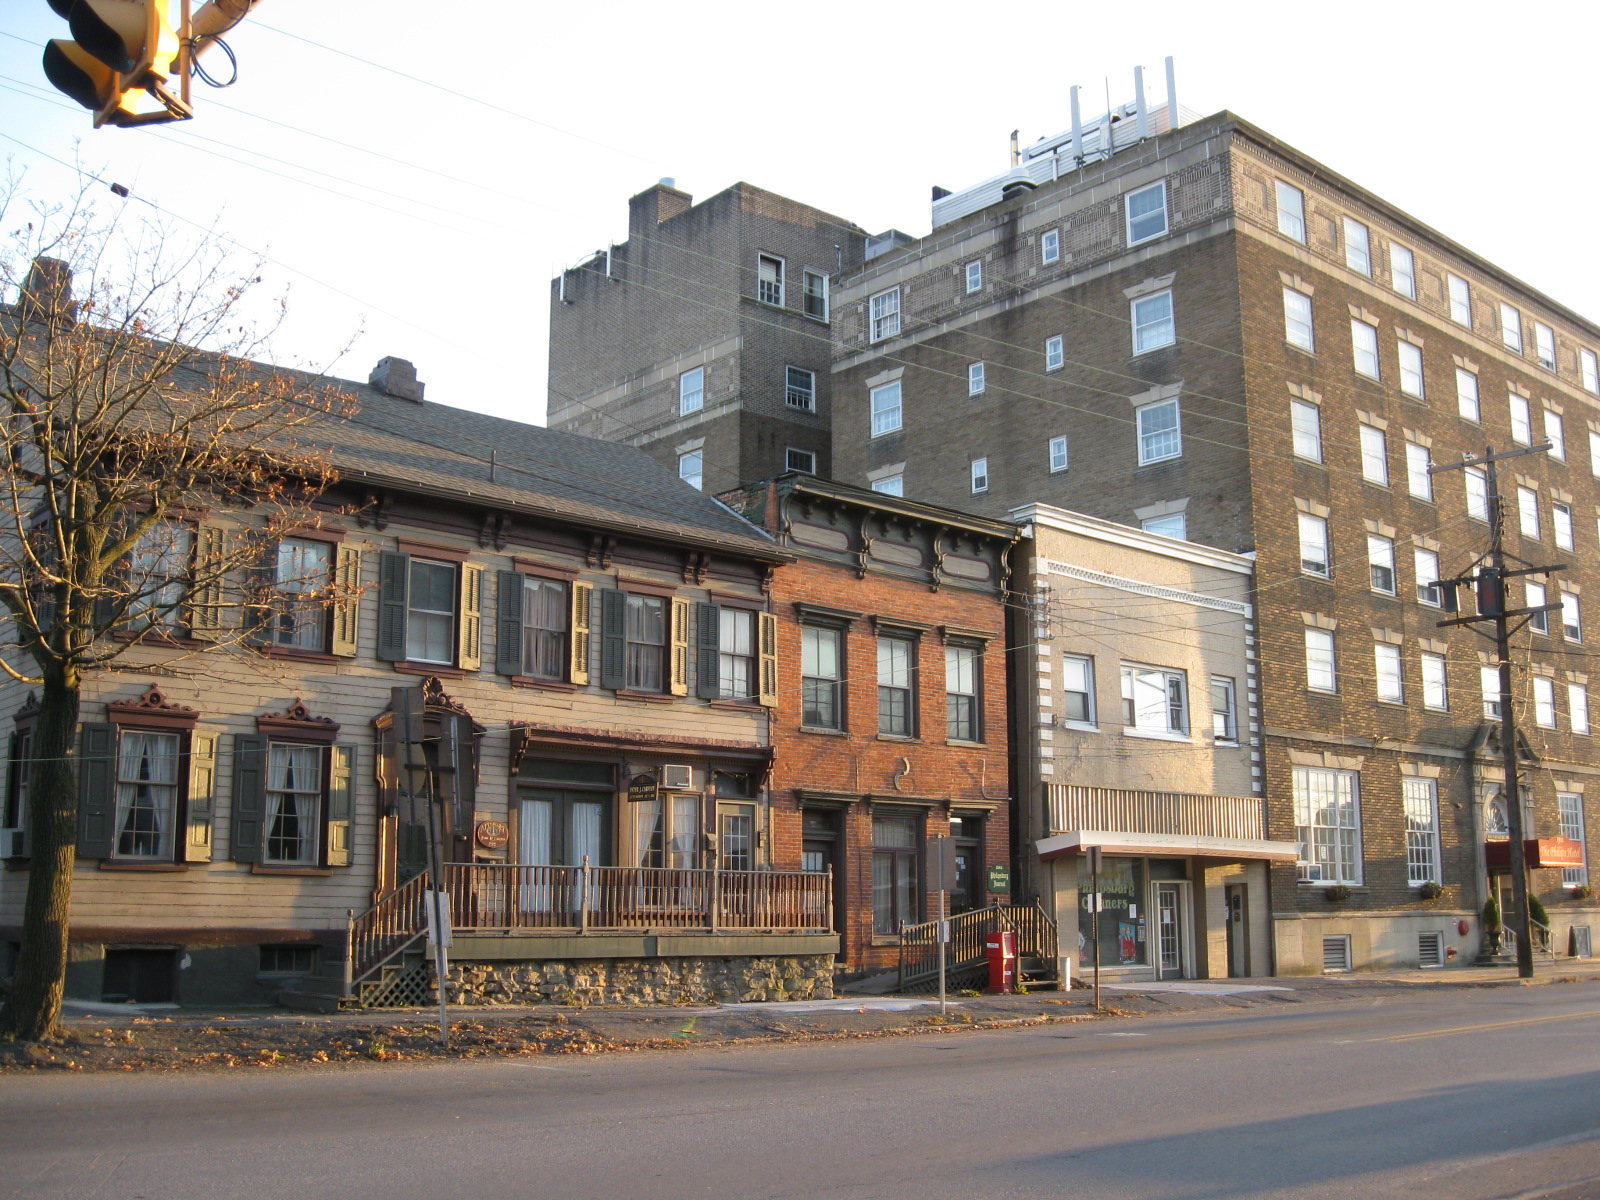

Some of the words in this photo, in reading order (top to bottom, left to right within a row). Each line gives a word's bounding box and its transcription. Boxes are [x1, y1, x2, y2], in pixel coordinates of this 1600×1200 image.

[1540, 845, 1550, 857] The
[1567, 847, 1581, 858] Hotel
[1081, 896, 1128, 909] Cners
